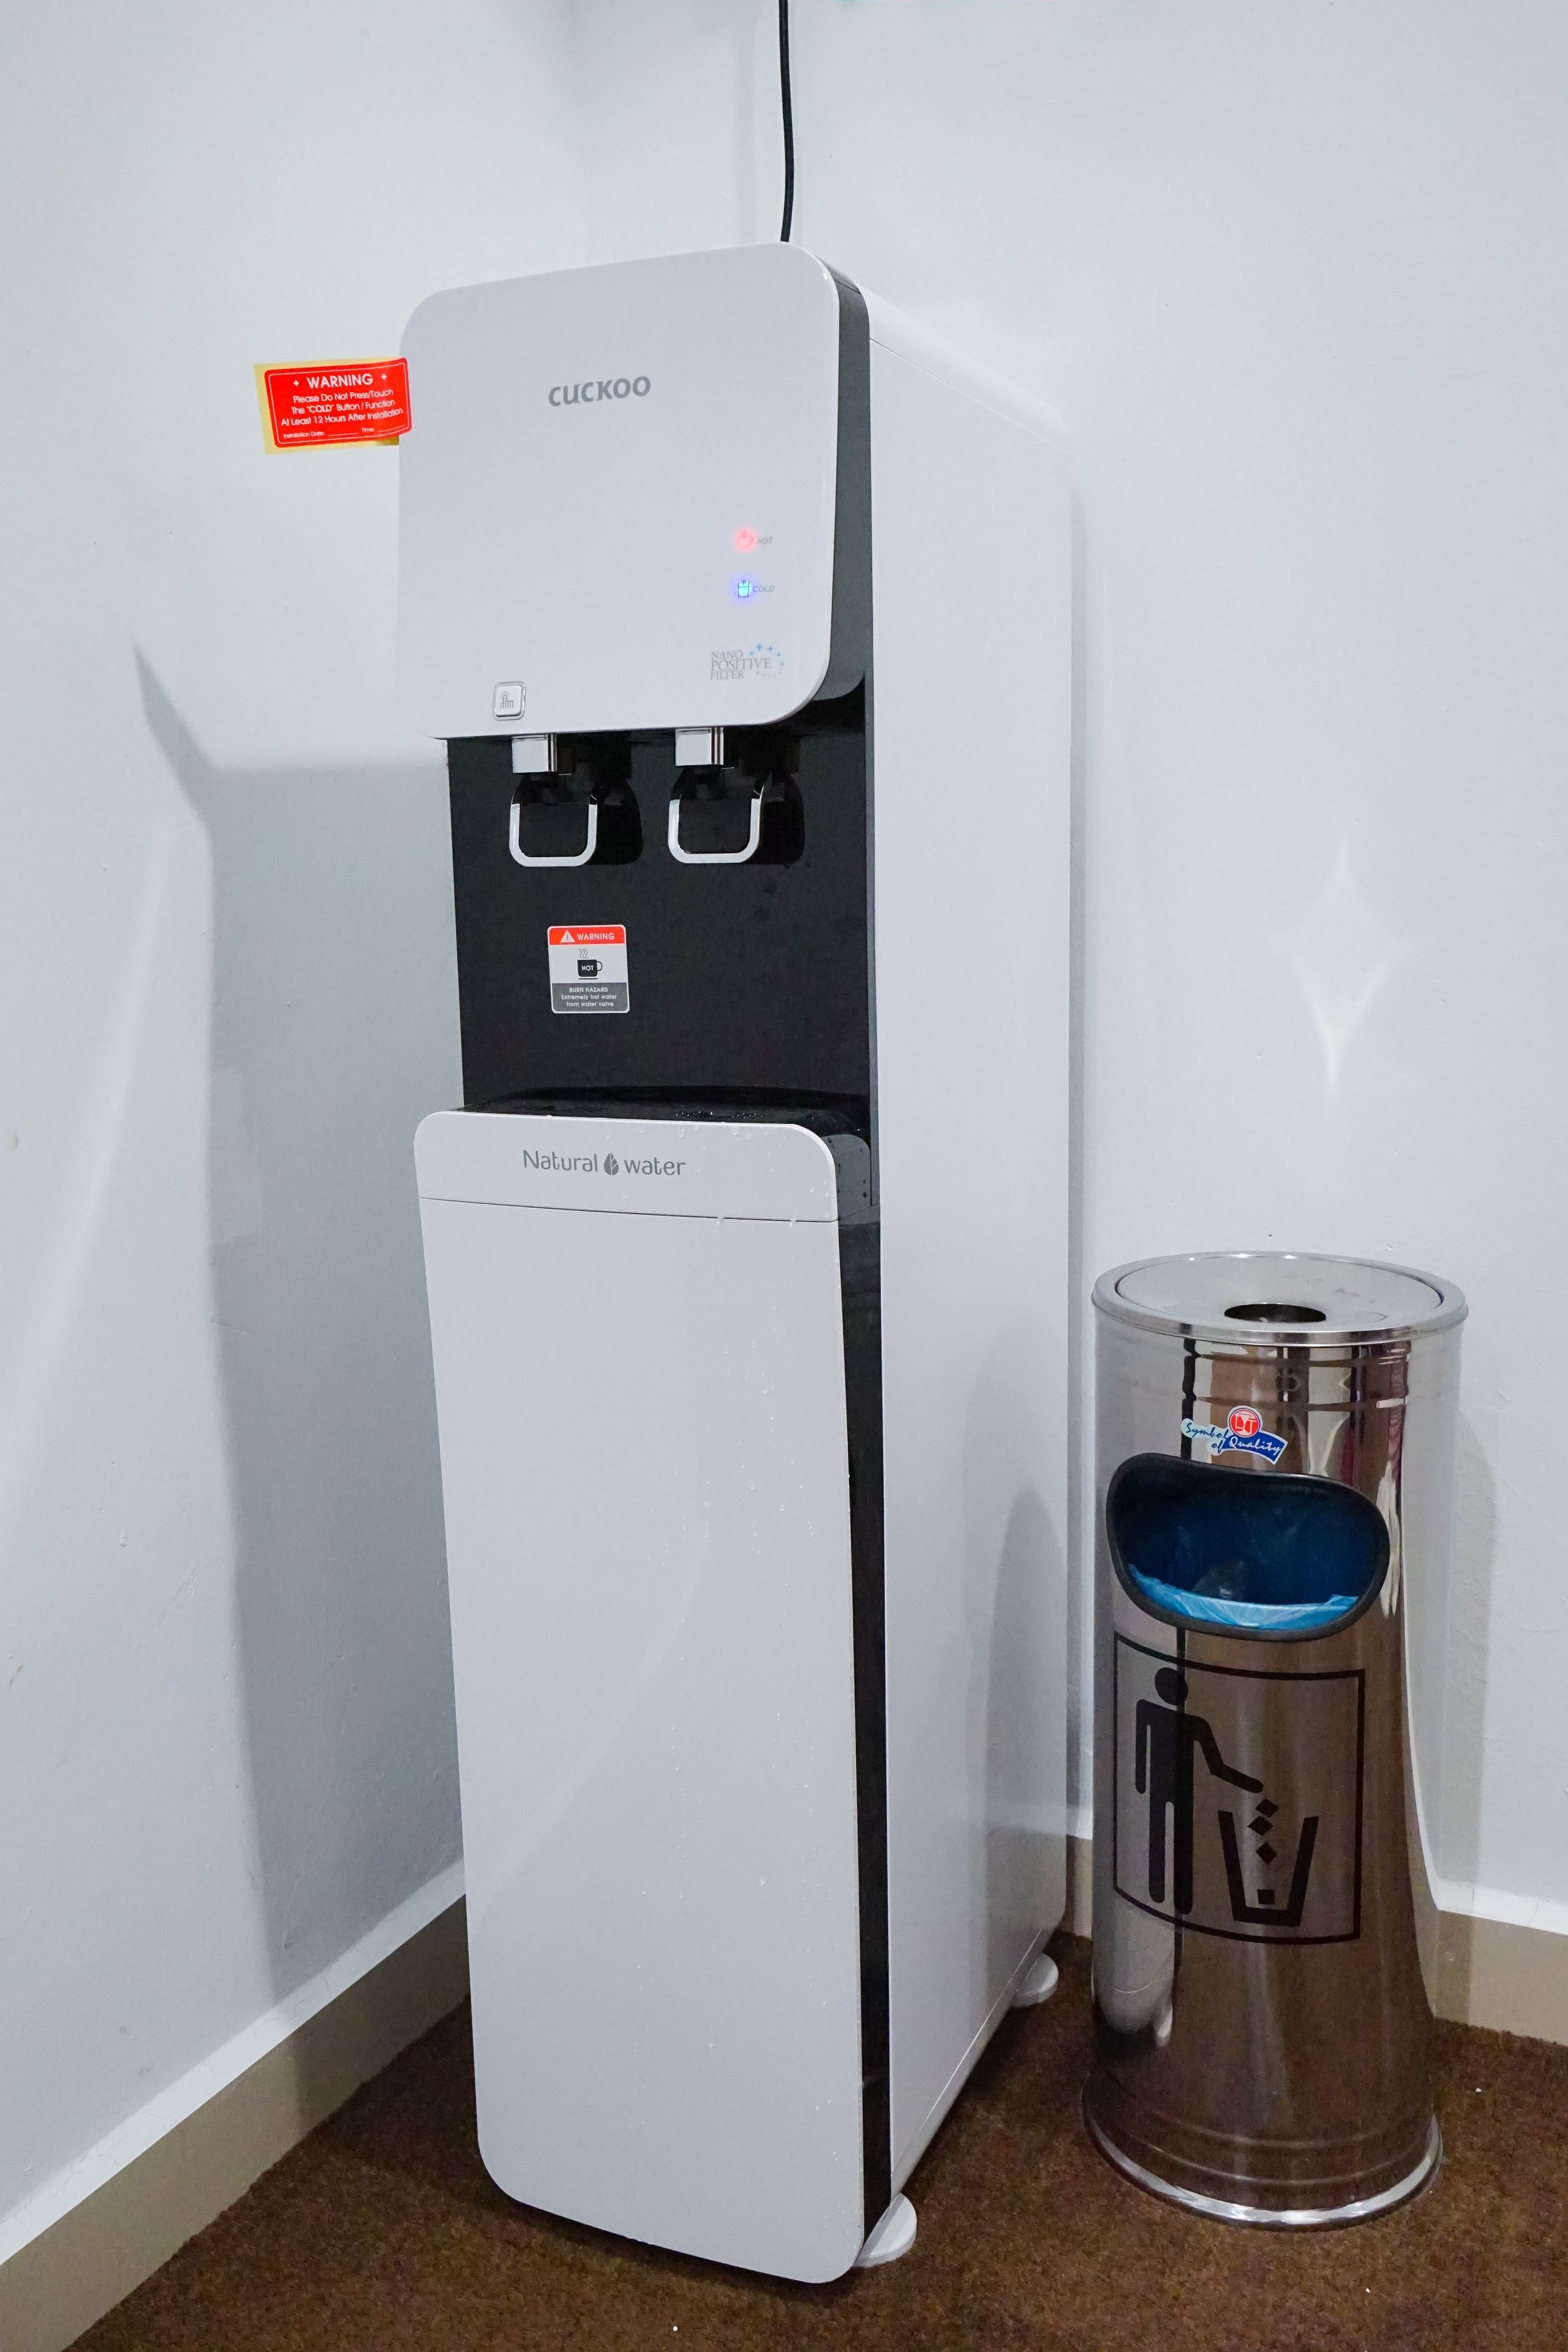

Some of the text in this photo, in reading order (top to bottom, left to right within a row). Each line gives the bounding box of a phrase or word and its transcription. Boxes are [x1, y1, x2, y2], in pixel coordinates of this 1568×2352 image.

[306, 373, 373, 389] WARNING
[549, 376, 650, 407] CUCKOO
[293, 395, 319, 404] Please
[337, 402, 360, 411] Button
[366, 399, 394, 409] Function
[291, 417, 311, 425] Least
[325, 413, 346, 423] Hours
[711, 650, 743, 660] NANO
[711, 657, 771, 671] POSITIVE
[710, 670, 744, 680] FILTER
[523, 1150, 686, 1175] Natural water
[1186, 1422, 1229, 1439] Symbol
[1211, 1436, 1281, 1455] of Quality
